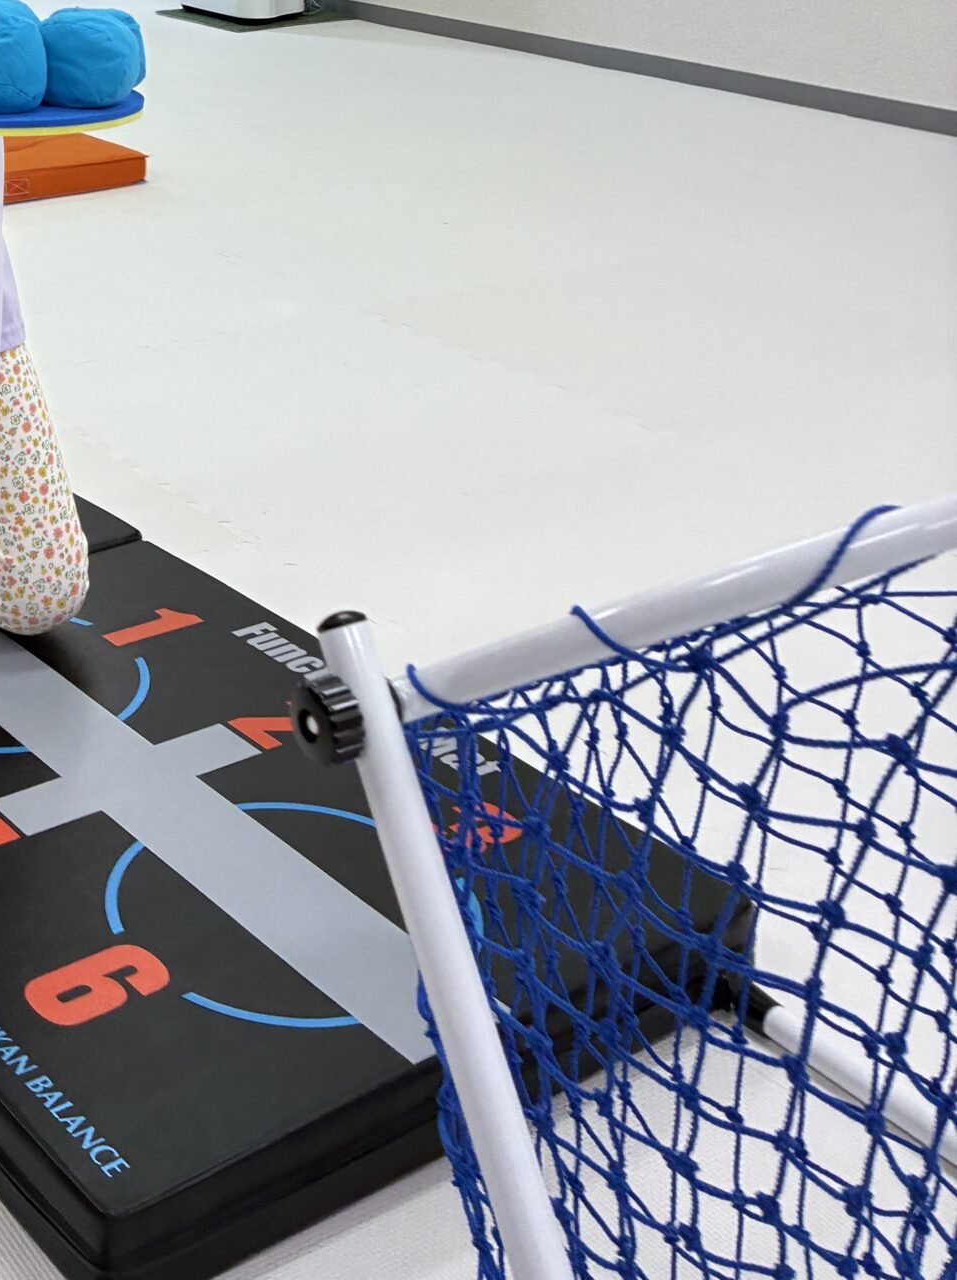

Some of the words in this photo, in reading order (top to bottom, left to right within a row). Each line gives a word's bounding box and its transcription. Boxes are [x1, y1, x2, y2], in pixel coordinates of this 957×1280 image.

[102, 608, 204, 646] 1
[24, 944, 171, 1027] 6
[24, 1075, 131, 1178] BALANCE
